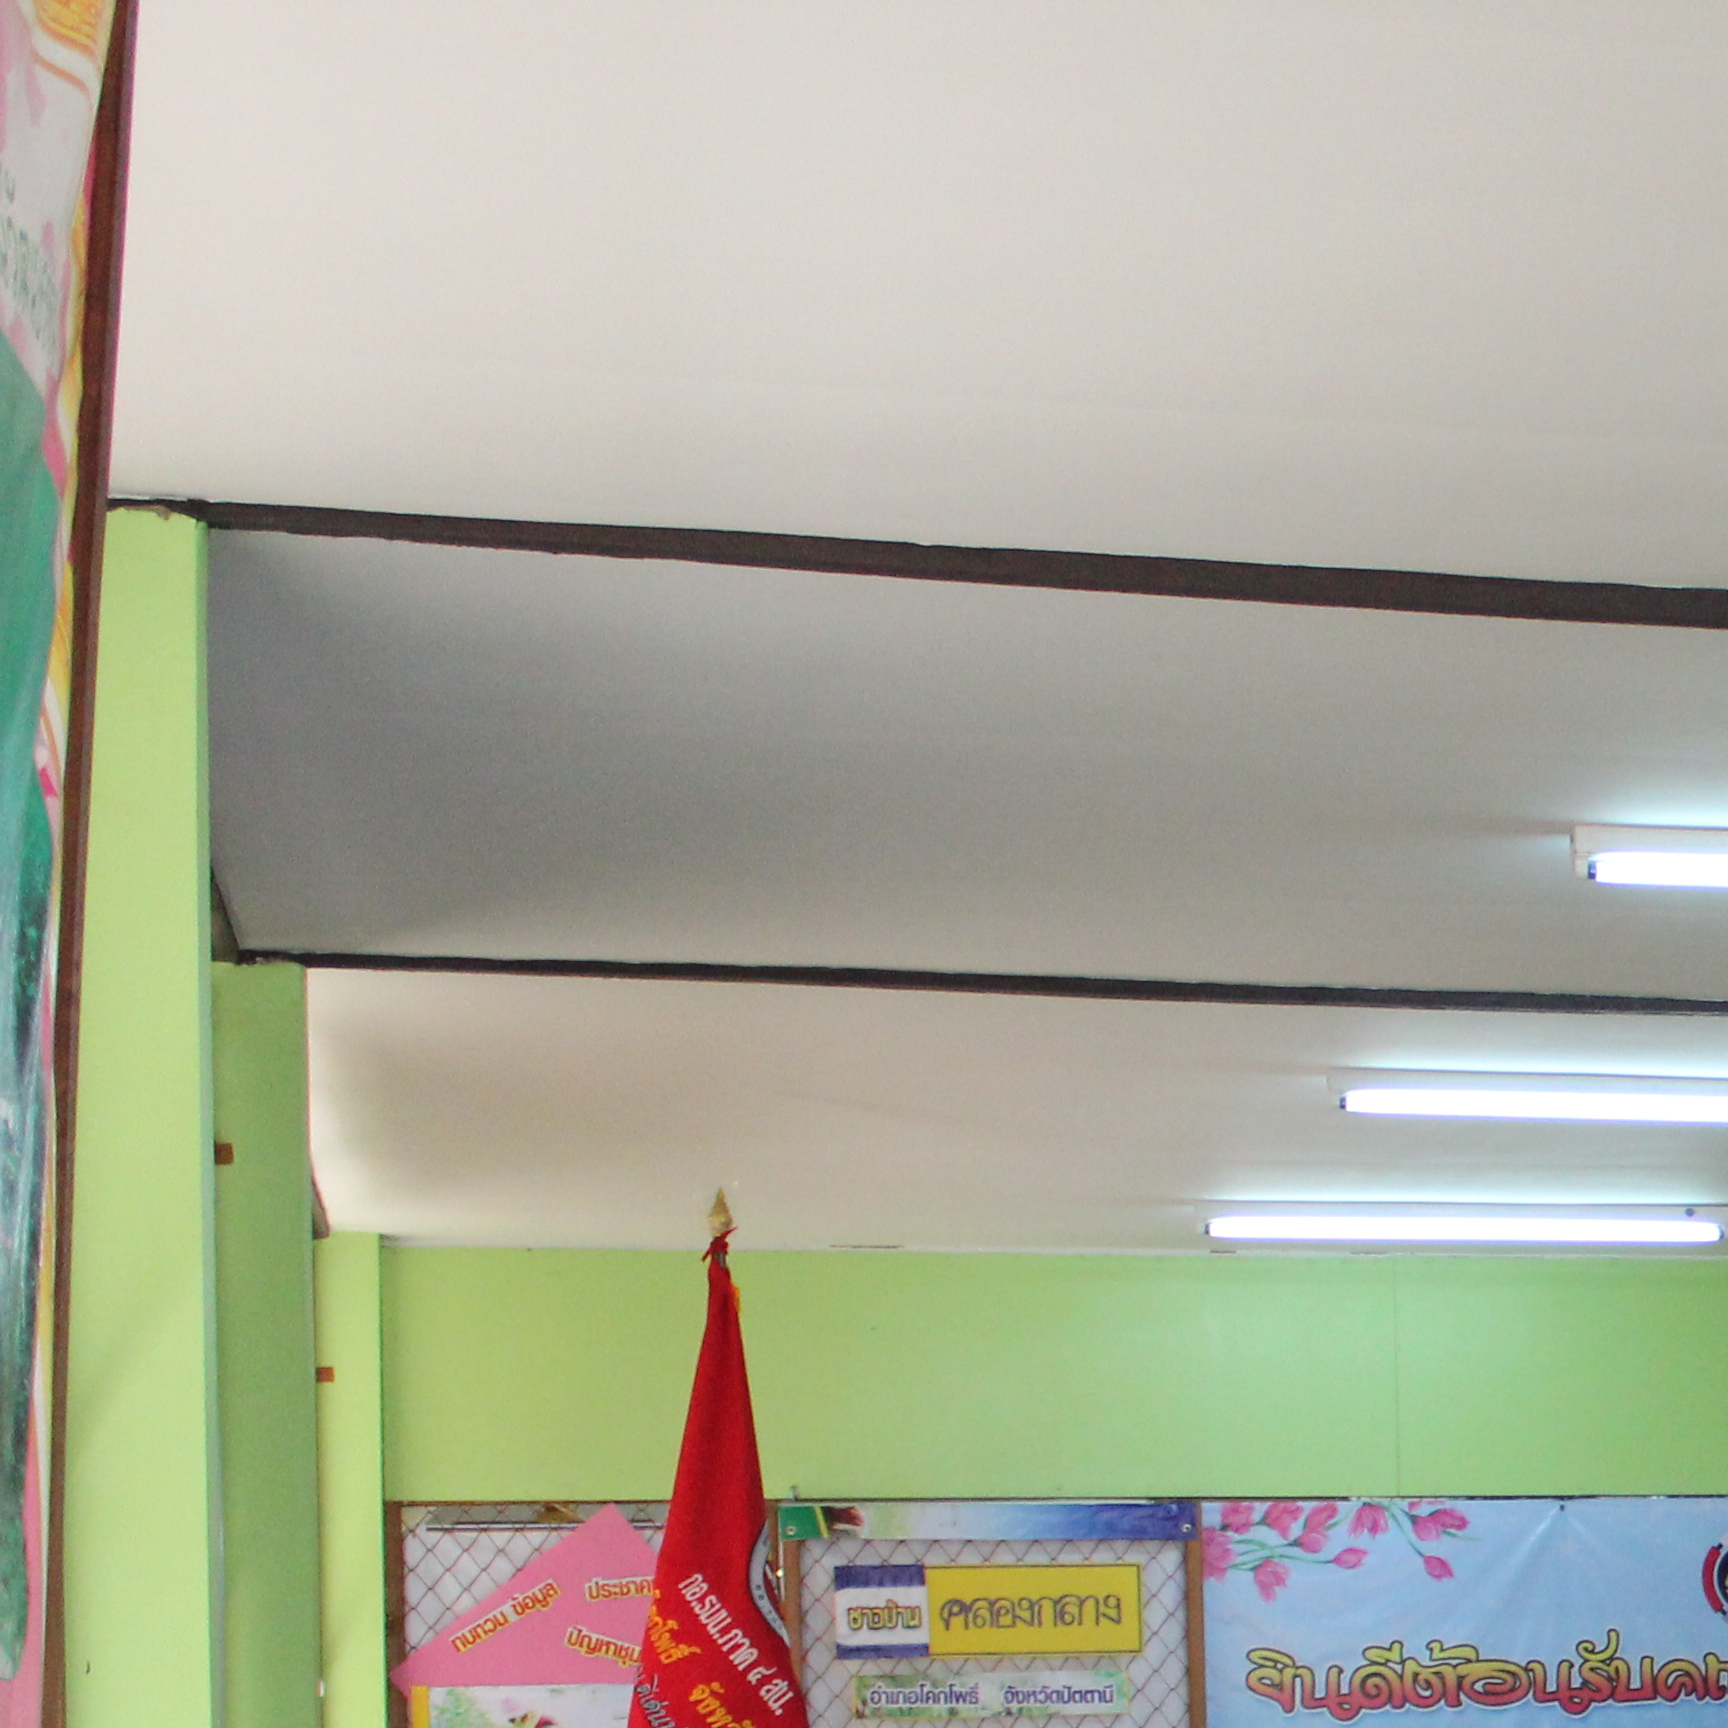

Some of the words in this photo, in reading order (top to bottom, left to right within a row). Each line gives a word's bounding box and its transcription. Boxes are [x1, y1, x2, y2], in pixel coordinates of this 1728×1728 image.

[449, 1611, 508, 1655] ทบทวน
[511, 1579, 562, 1622] ข้อมูล
[846, 1598, 922, 1631] ชาวบ้าน
[939, 1593, 1122, 1633] คลองกลาง
[868, 1682, 980, 1706] อำเภอโคกโพธิ์
